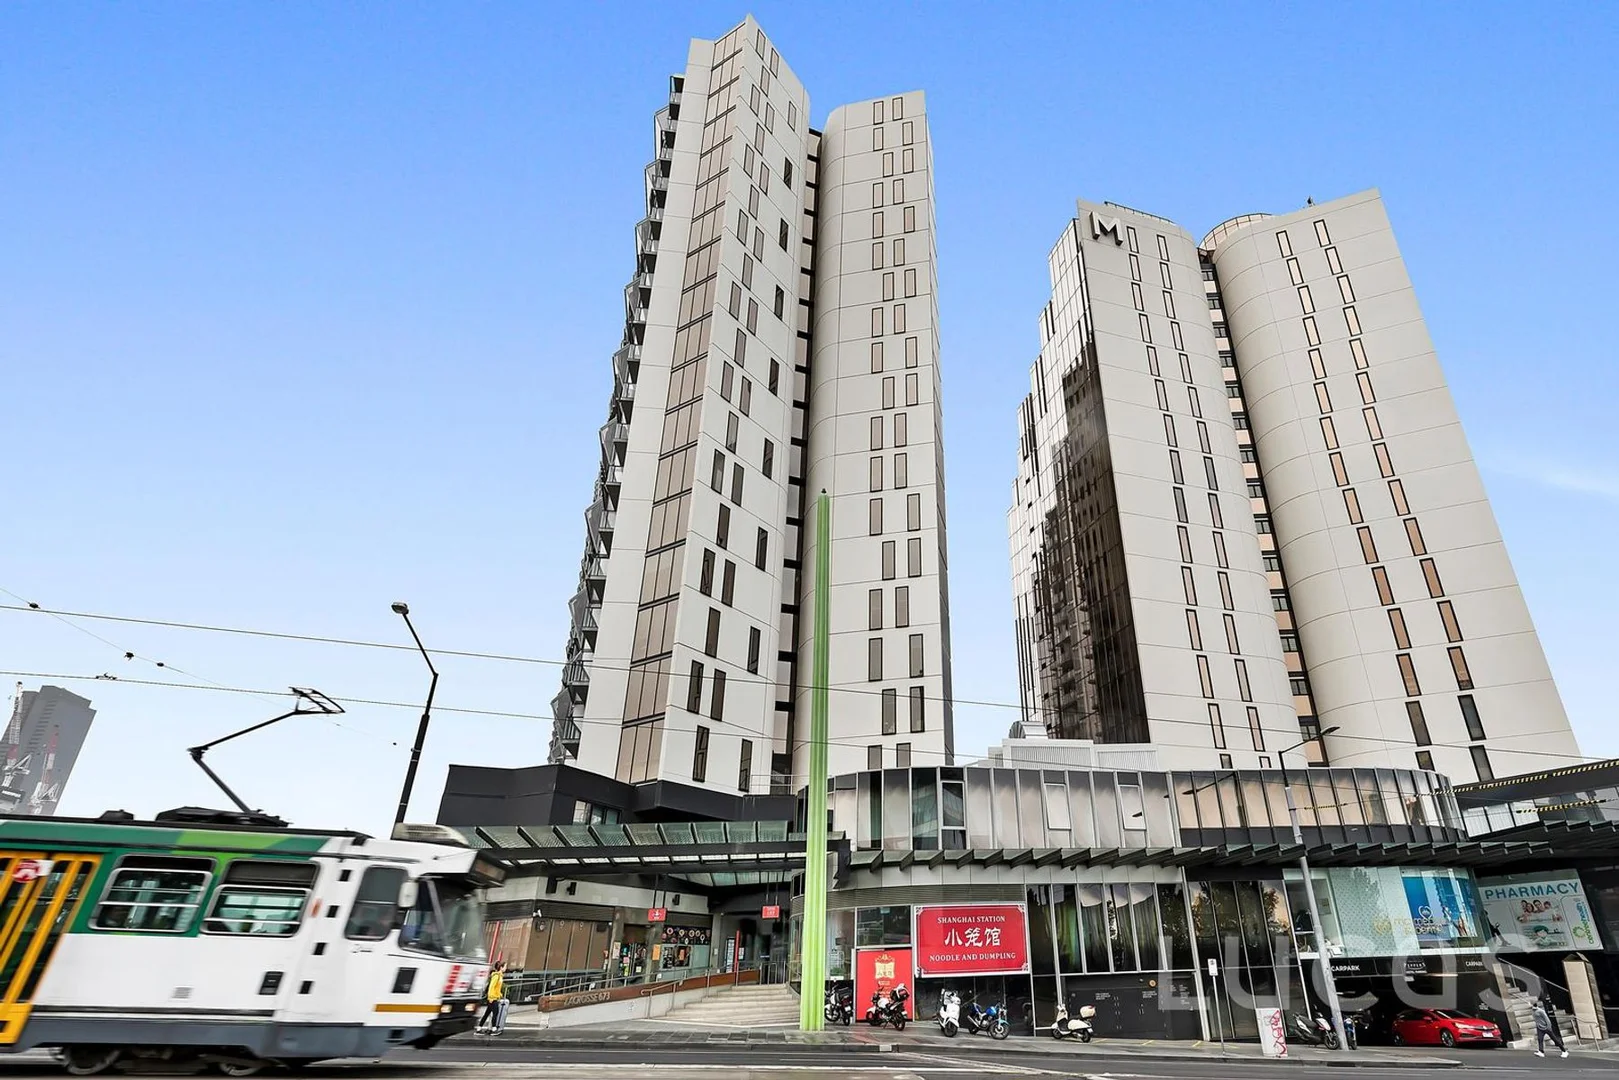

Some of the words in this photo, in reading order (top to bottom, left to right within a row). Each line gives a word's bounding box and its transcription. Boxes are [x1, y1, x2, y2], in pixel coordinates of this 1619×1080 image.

[1089, 211, 1124, 246] M
[1484, 882, 1579, 900] PHARMACY
[944, 927, 1001, 947] 小笼馆
[929, 954, 960, 962] NOODLE
[980, 952, 1016, 960] DUMPLING
[564, 993, 599, 1006] LACROSSE
